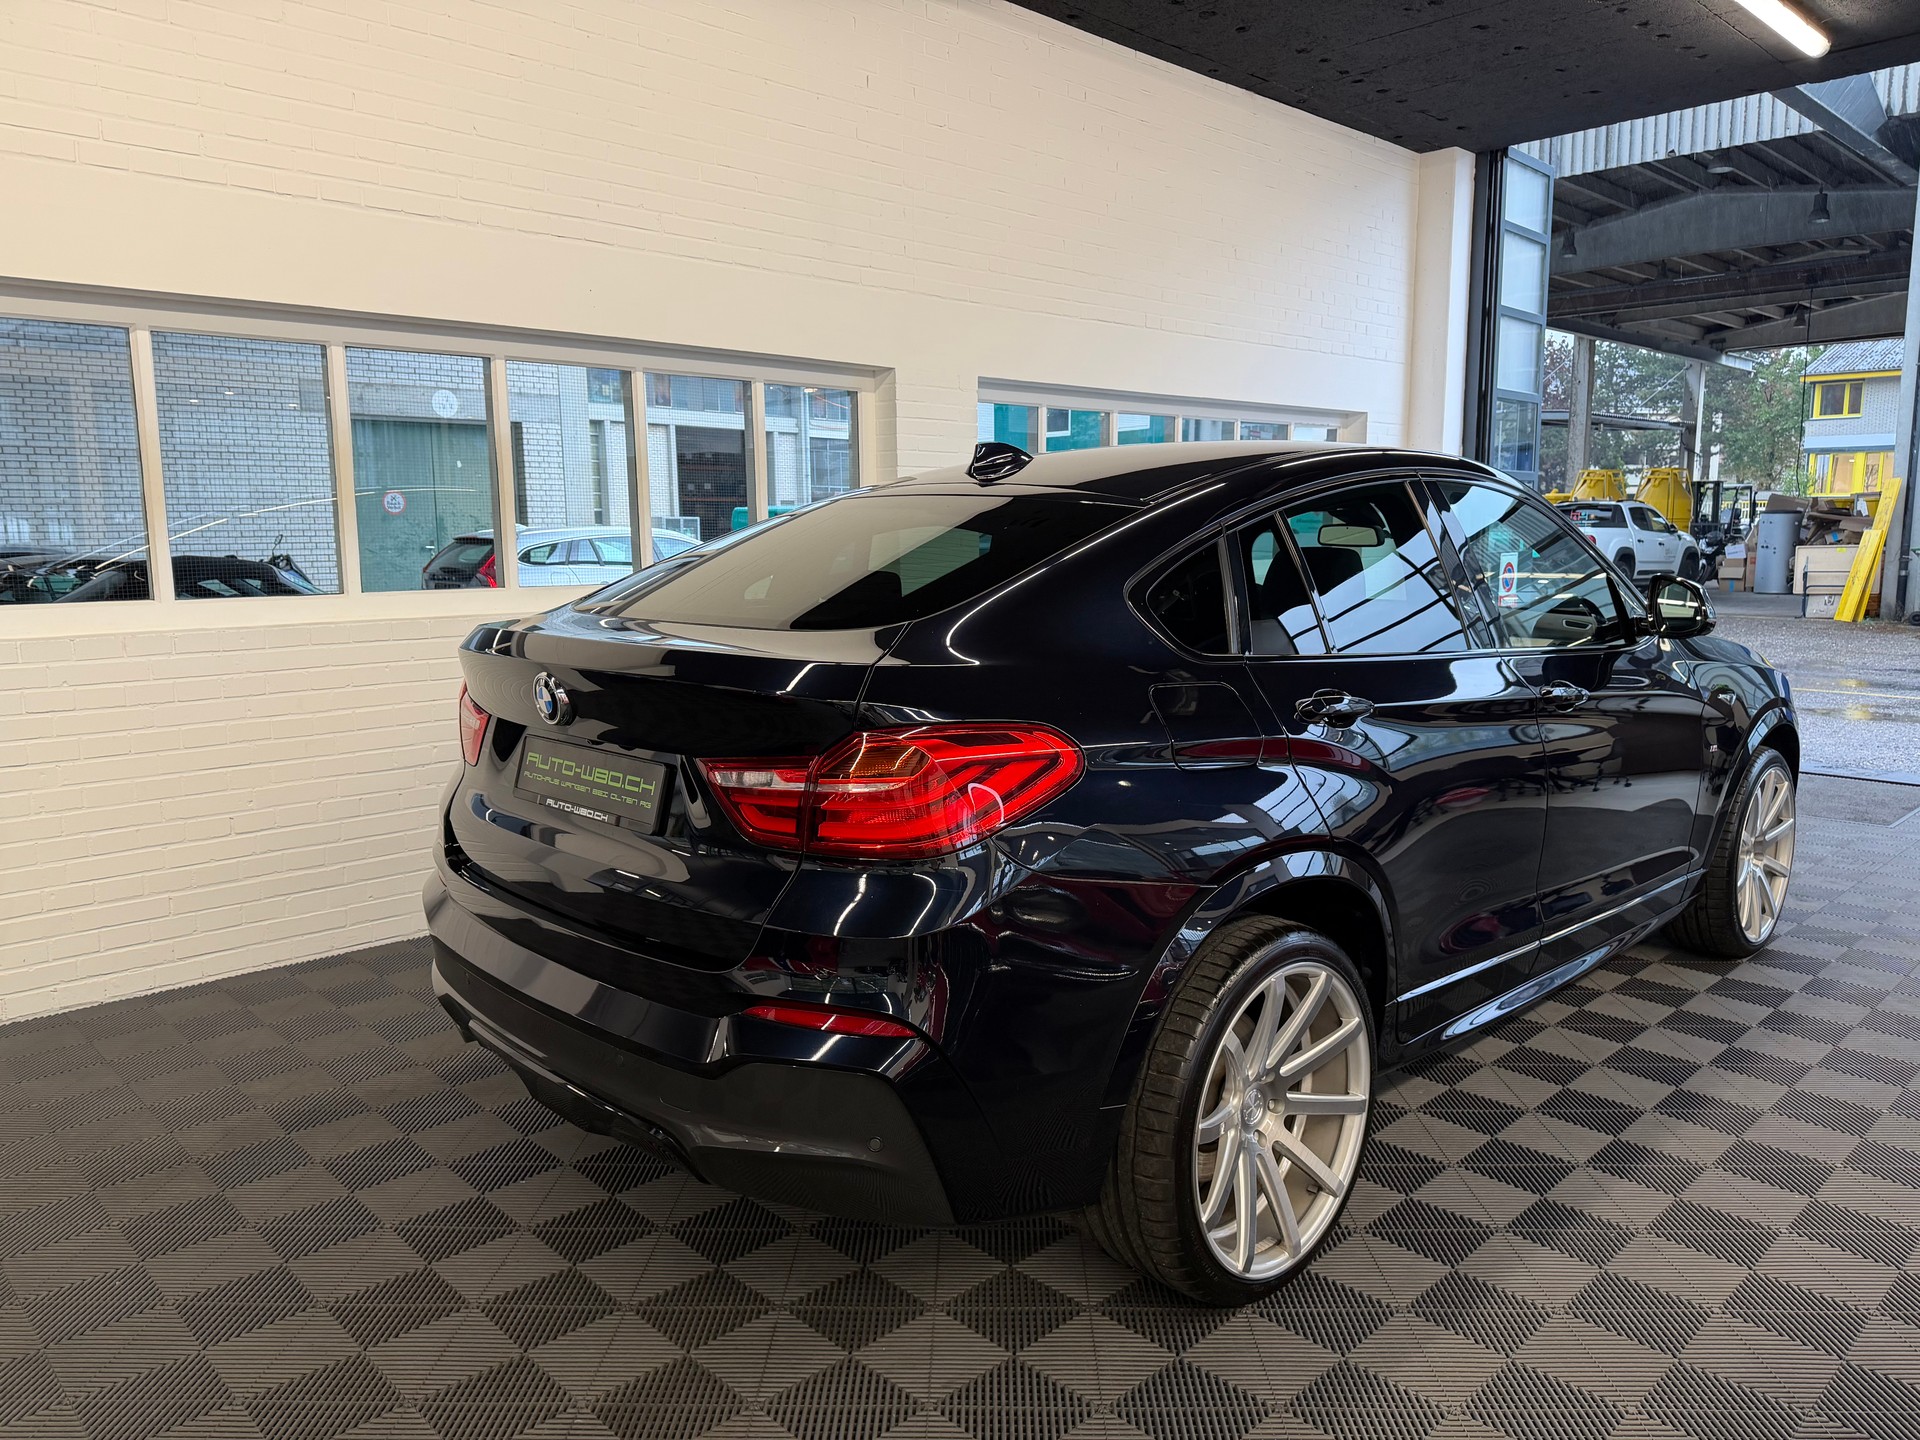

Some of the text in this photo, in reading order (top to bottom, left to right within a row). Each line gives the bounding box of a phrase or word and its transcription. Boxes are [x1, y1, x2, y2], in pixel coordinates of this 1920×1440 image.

[524, 771, 560, 785] AUTOHAUS
[639, 800, 652, 809] AG
[526, 752, 656, 796] AUTO-WBO.CH
[545, 798, 609, 822] AUTO-WBO.CH
